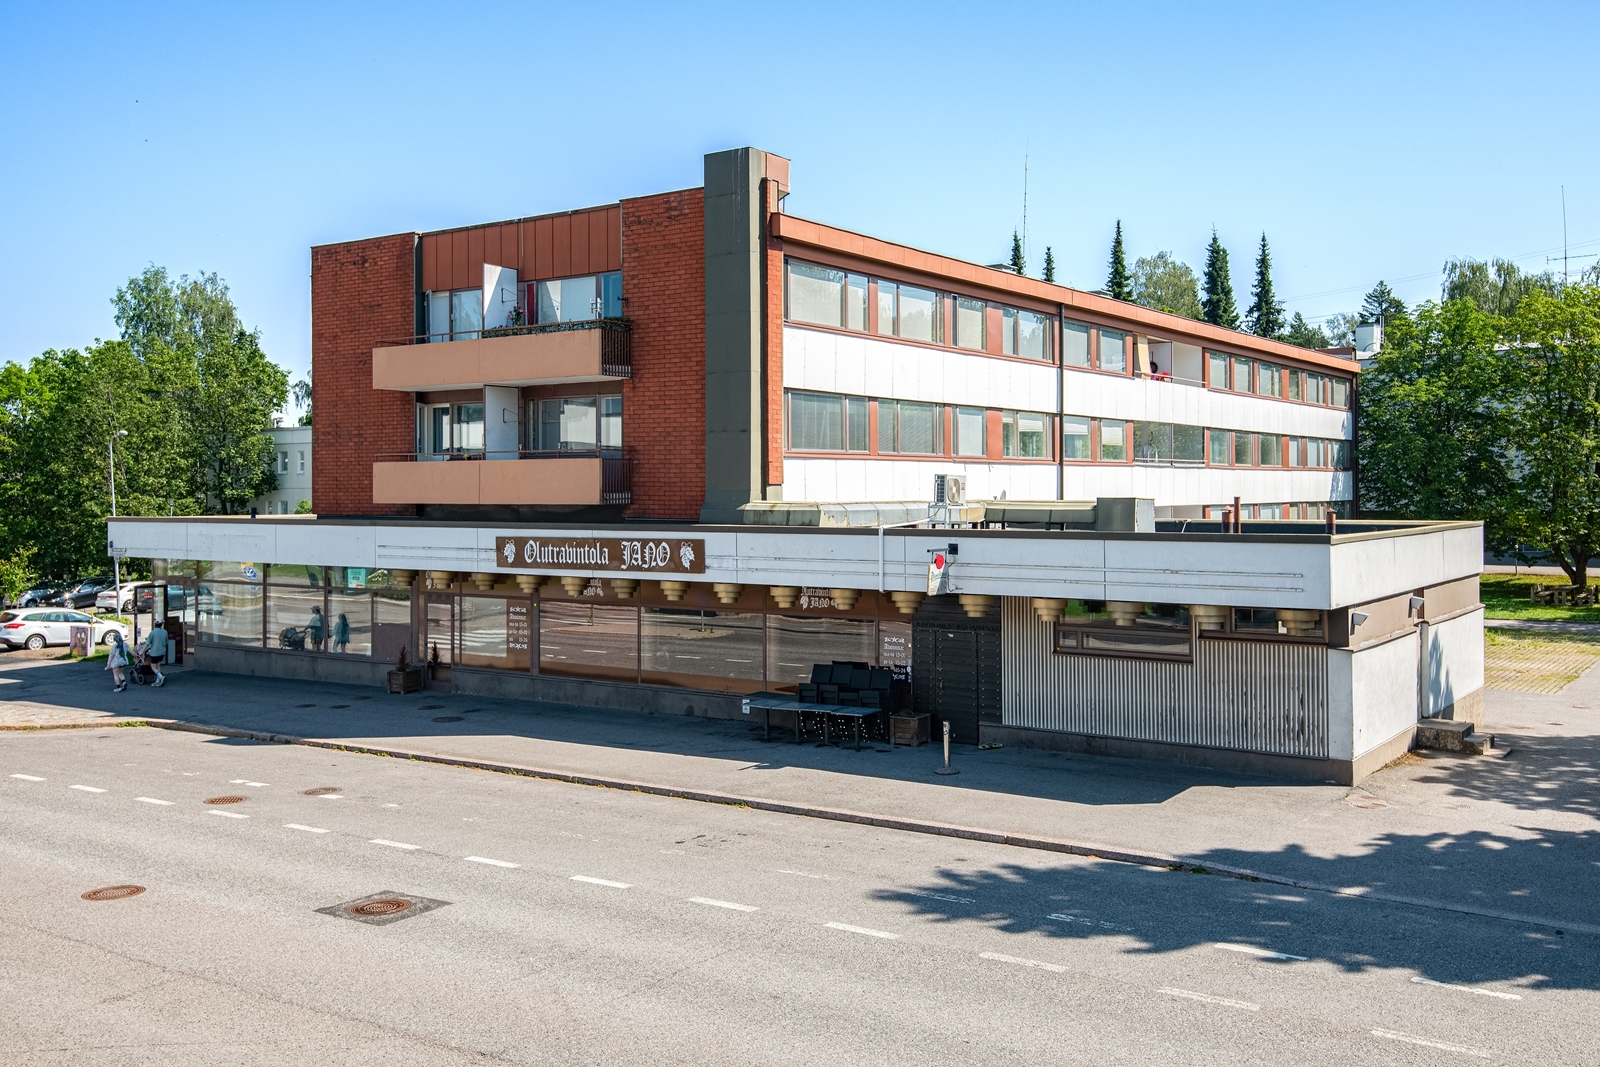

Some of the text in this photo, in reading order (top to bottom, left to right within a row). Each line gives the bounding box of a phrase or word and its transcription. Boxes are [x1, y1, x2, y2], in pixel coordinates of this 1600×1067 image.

[524, 539, 671, 570] Olutravintola JANO
[810, 597, 830, 608] JANO
